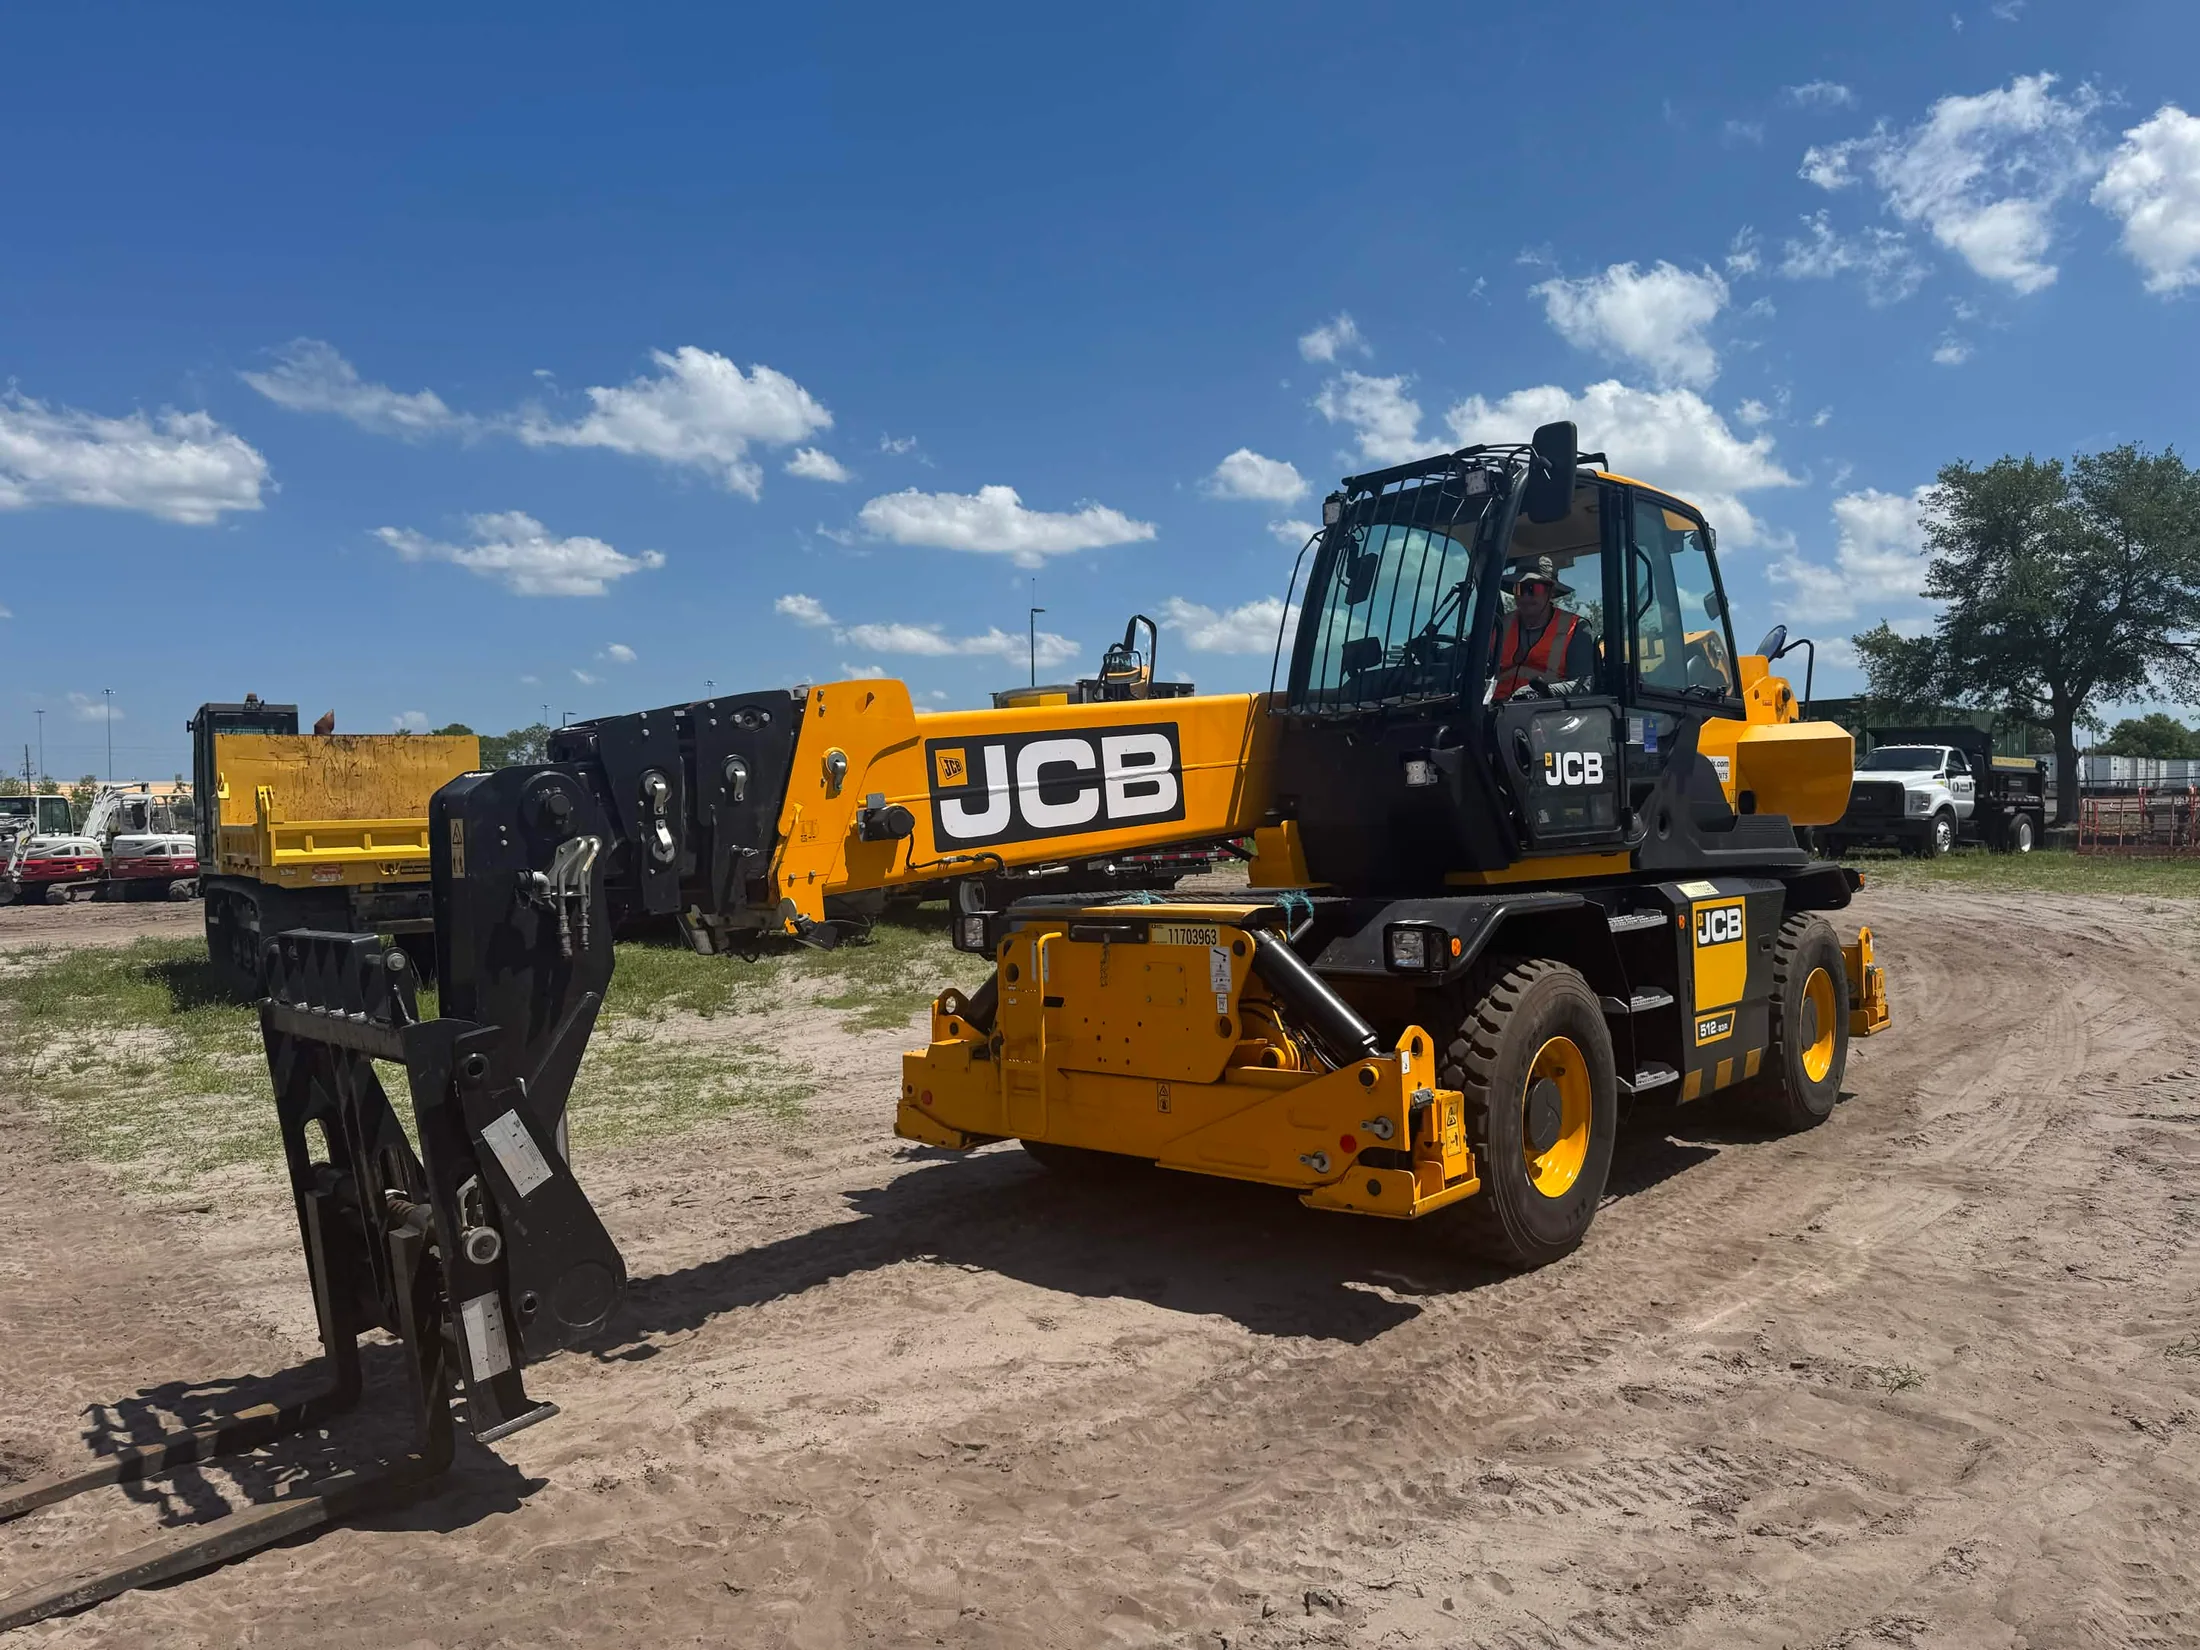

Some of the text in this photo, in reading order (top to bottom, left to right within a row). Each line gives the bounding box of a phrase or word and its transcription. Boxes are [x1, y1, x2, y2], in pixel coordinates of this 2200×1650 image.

[940, 733, 1178, 838] JCB
[943, 759, 962, 777] JCB
[1545, 751, 1604, 786] JCB
[1168, 928, 1217, 945] 11703963
[1697, 908, 1742, 944] JCB
